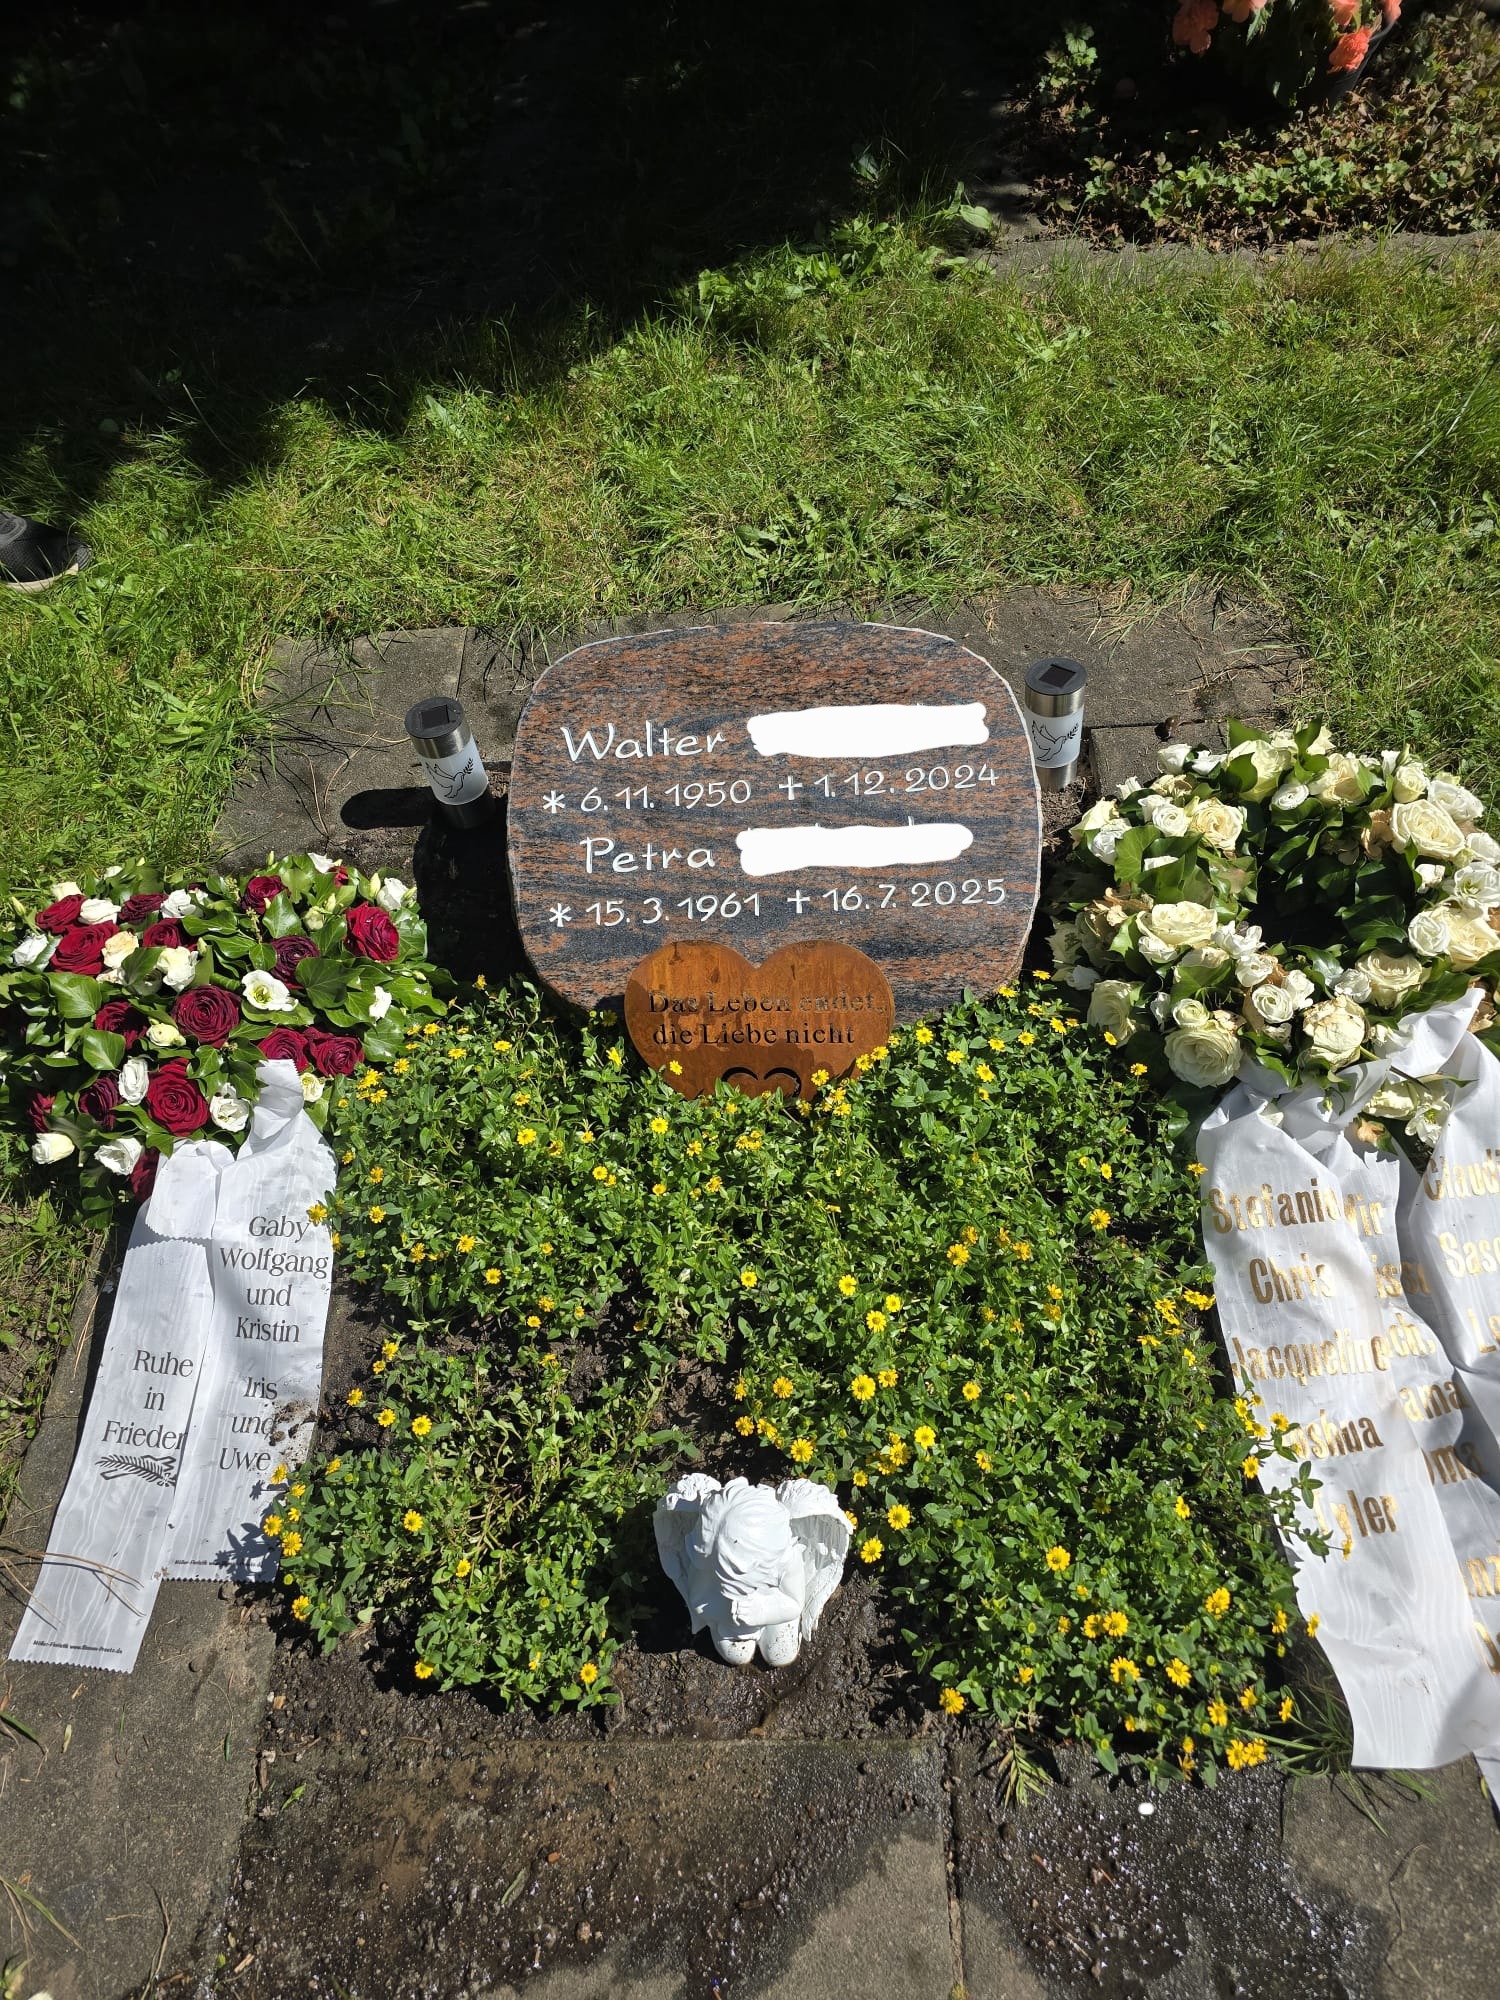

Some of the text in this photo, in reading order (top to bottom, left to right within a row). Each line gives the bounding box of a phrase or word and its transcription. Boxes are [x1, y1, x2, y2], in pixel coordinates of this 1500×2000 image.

[560, 720, 725, 762] Walter
[580, 837, 715, 874] Petra
[649, 991, 698, 1013] Das
[707, 991, 792, 1013] Leben
[653, 1022, 856, 1045] die Liebe nicht
[1208, 1177, 1342, 1233] Stefanie
[249, 1215, 310, 1243] Gaby
[220, 1247, 329, 1279] Wolfgang
[1249, 1252, 1336, 1304] Chris
[246, 1284, 292, 1306] und
[235, 1316, 301, 1342] Kristin
[132, 1349, 194, 1377] Ruhe
[1231, 1328, 1393, 1386] Jacqueline
[143, 1386, 165, 1411] in
[243, 1377, 278, 1400] Iris
[1399, 1381, 1472, 1422] ama
[1282, 1409, 1384, 1459] oshua
[219, 1447, 271, 1471] Uwe
